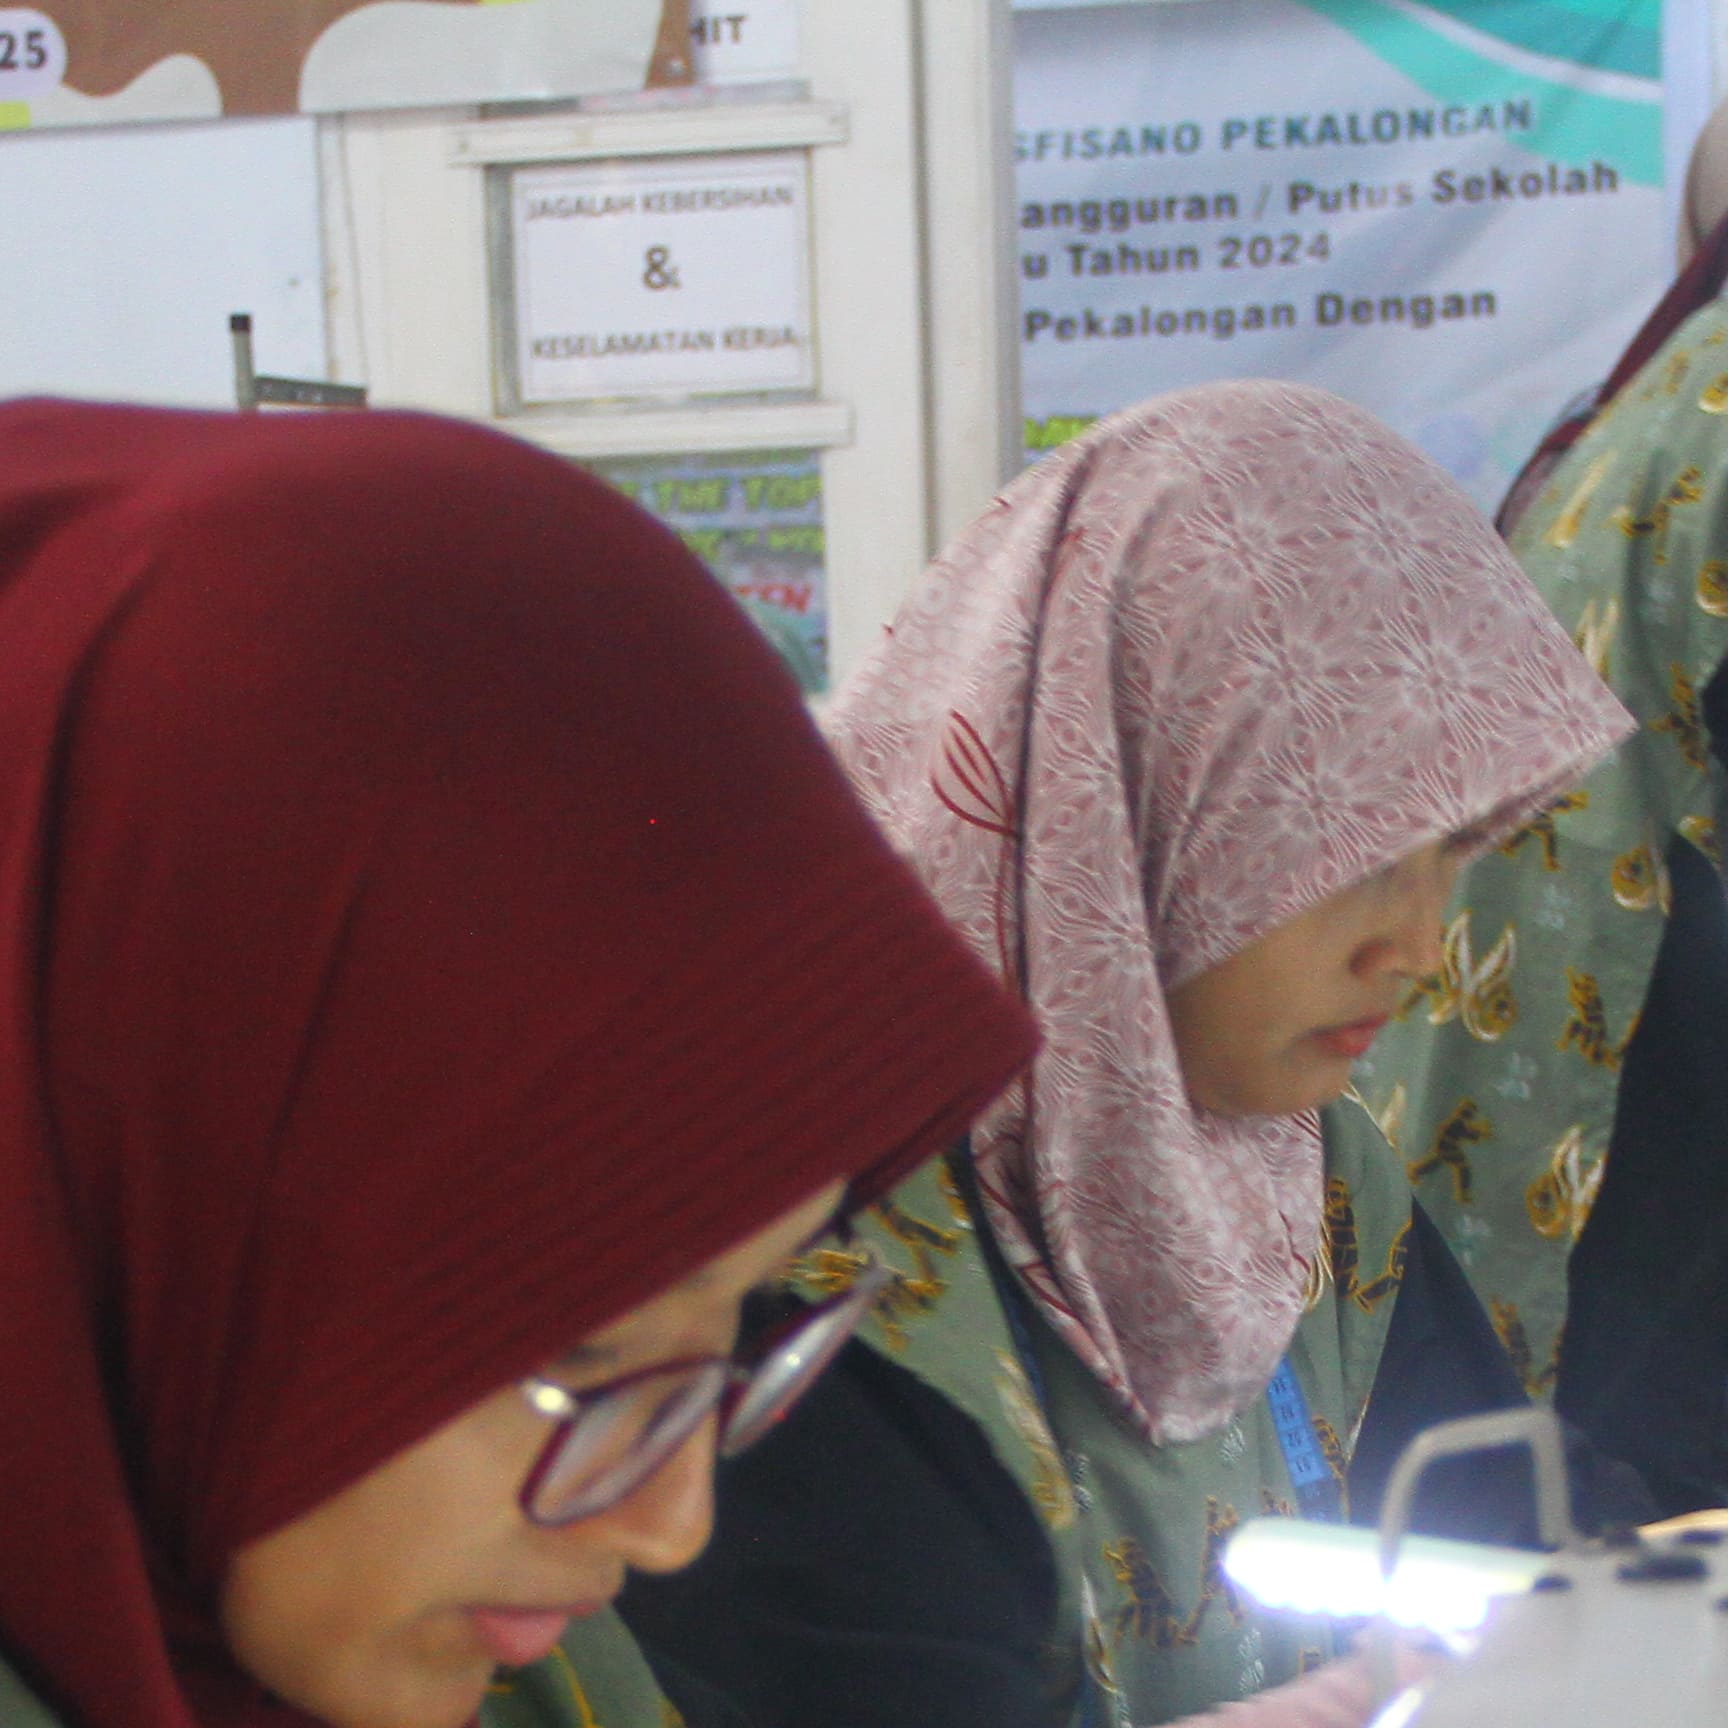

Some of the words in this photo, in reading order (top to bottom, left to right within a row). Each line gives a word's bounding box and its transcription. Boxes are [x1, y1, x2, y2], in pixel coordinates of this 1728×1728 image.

[1221, 99, 1531, 152] PEKALONGAN
[1021, 192, 1239, 235] angguran
[1286, 178, 1414, 216] Putus
[1431, 160, 1619, 203] Sekolah
[642, 245, 683, 291] &
[1065, 240, 1200, 277] Tahun
[1218, 231, 1331, 270] 2024
[1024, 304, 1297, 343] Pekalongan
[1315, 290, 1497, 330] Dengan
